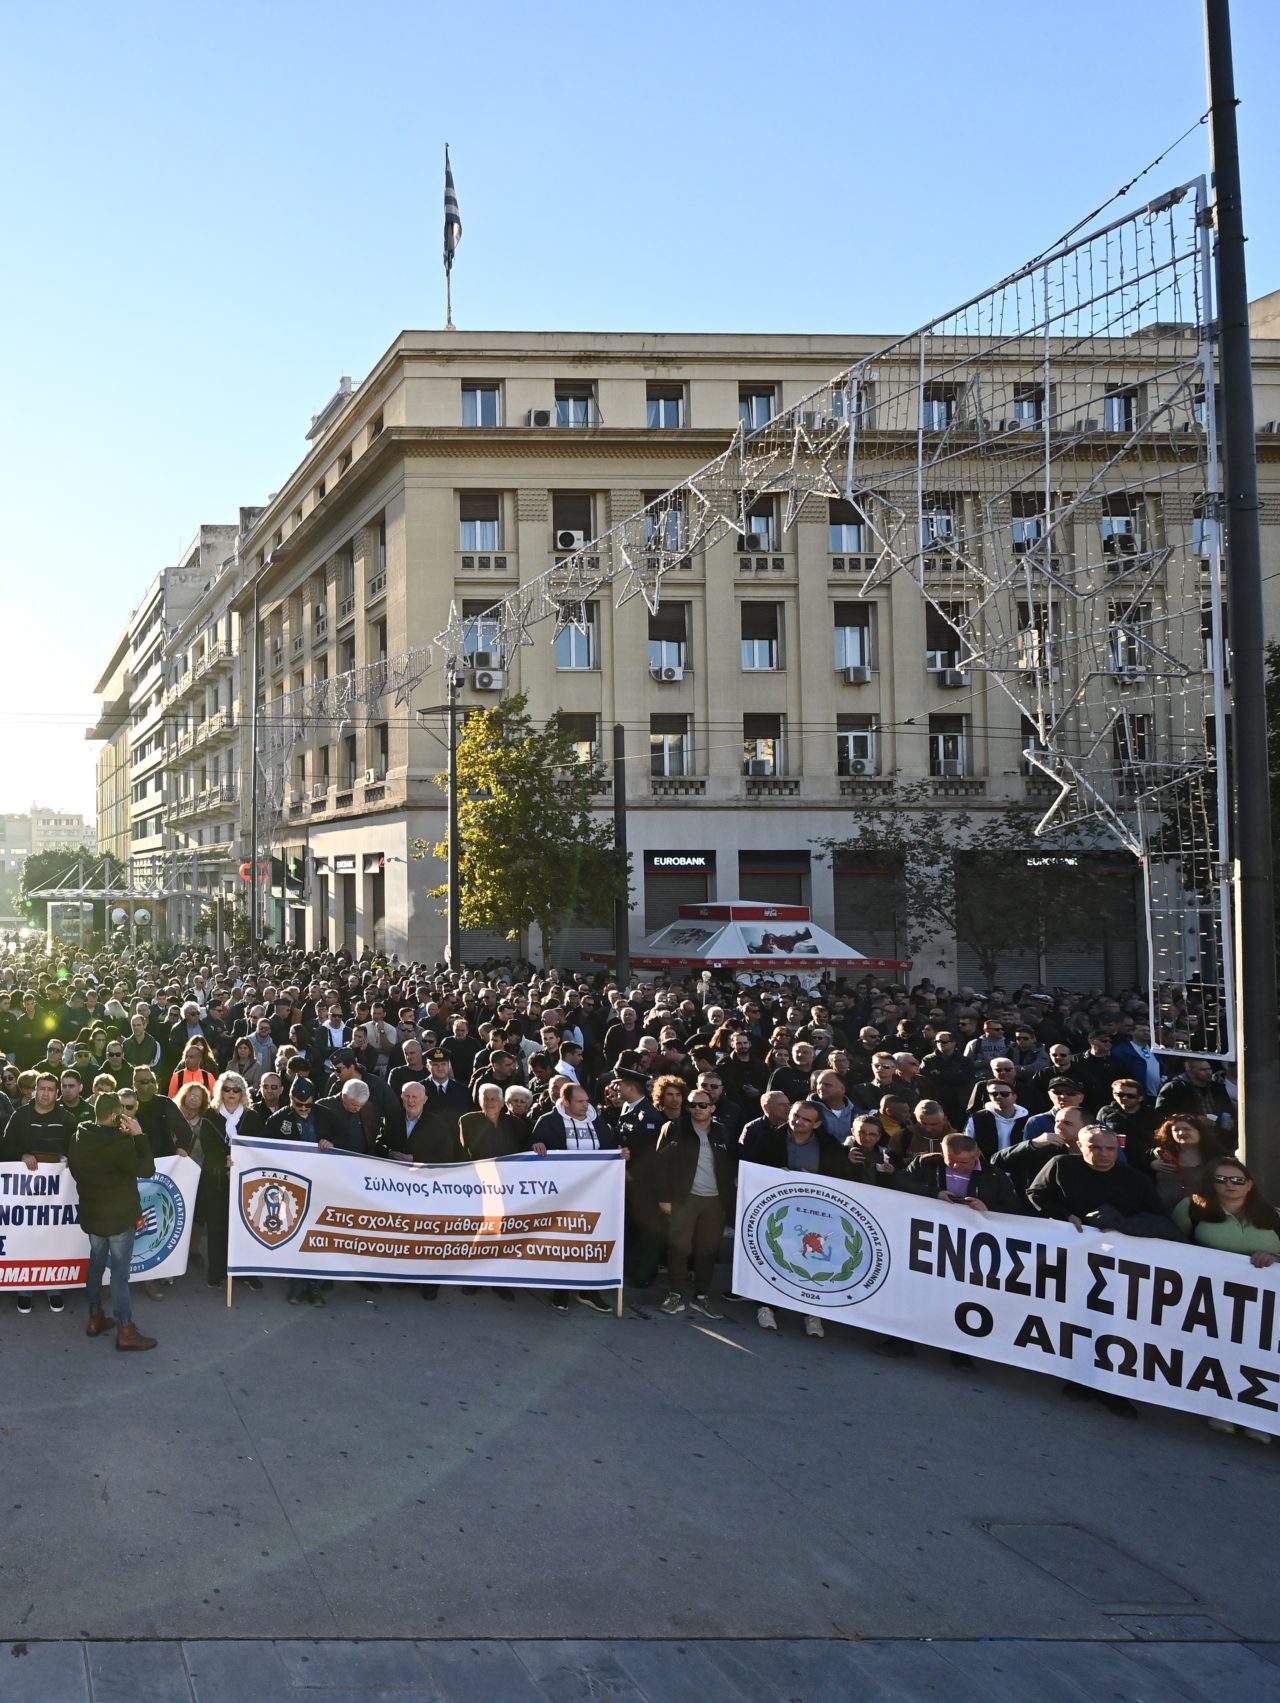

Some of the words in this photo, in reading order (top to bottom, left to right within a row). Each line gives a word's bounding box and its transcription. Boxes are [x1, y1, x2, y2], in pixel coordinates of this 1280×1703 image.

[653, 857, 706, 866] EUROBANK
[364, 1176, 429, 1197] Σύλλογος
[432, 1180, 515, 1198] Αποφοίτων
[519, 1180, 559, 1195] ΣΤΥΑ
[777, 1187, 850, 1208] ΠΕΡΙΦΕΡΕΙΑΚΗΣ
[173, 1192, 185, 1250] ΣΤΡΑΤΙΩΤΙΚΩΝ
[325, 1208, 354, 1227] Στις
[358, 1213, 410, 1232] σχολές
[413, 1219, 440, 1233] μας
[444, 1217, 496, 1233] μάθαμε
[498, 1217, 531, 1233] ήθος
[533, 1216, 552, 1228] και
[556, 1213, 592, 1231] τιμή,
[747, 1193, 778, 1239] ΣΤΡΑΤΙΩΤΙΚΩΝ
[849, 1205, 882, 1247] ΕΝΟΤΗΤΑΣ
[309, 1235, 329, 1248] και
[333, 1237, 410, 1257] παίρνουμε
[414, 1243, 499, 1259] υποβάθμιση
[502, 1243, 523, 1258] ως
[526, 1243, 608, 1260] ανταμοιβή!
[749, 1240, 765, 1267] ΕΝΩΣΗ
[862, 1248, 884, 1290] ΙΩΑΝΝΙΝΩΝ
[800, 1291, 821, 1301] 2024
[908, 1217, 1068, 1304] ΕΝΩΣΗ
[1086, 1251, 1280, 1354] ΣΤΡΑΤΙ
[954, 1301, 994, 1338] Ο
[1013, 1313, 1280, 1413] ΑΓΩΝΑΣ
